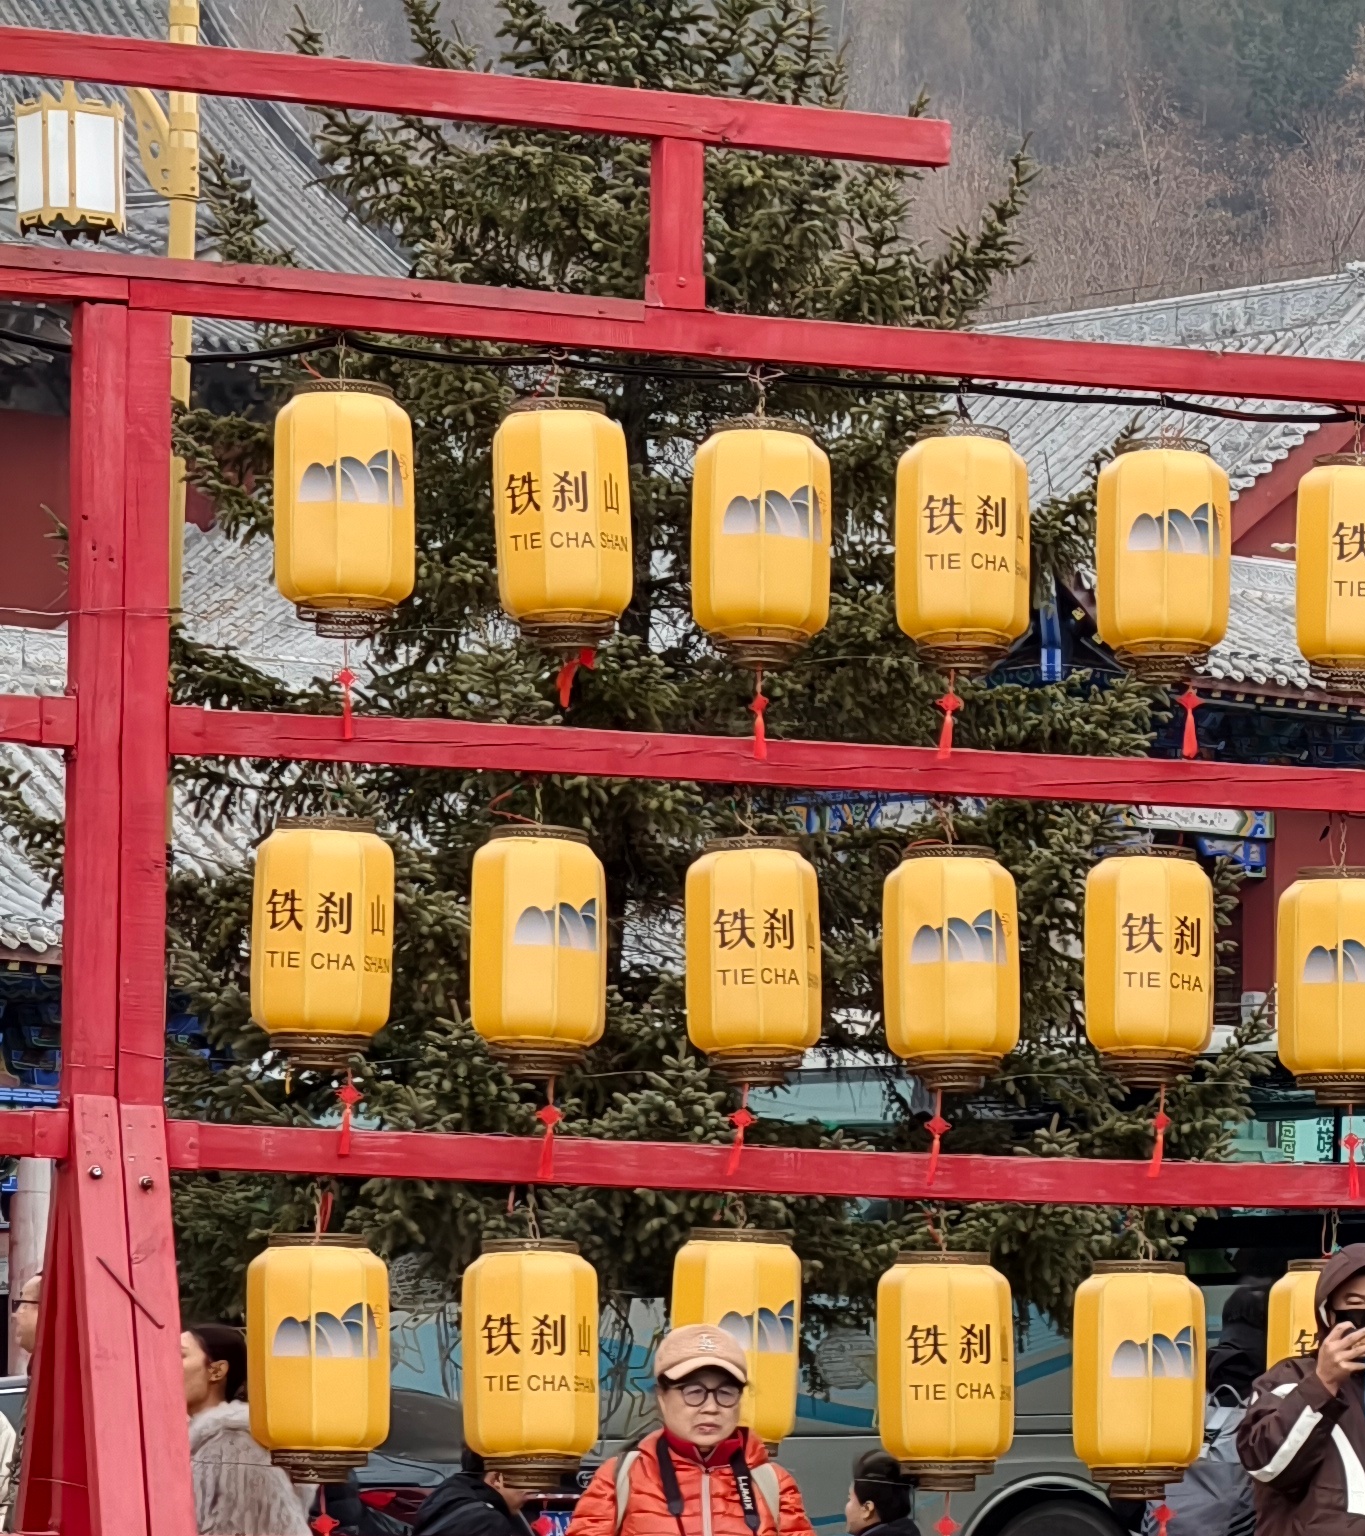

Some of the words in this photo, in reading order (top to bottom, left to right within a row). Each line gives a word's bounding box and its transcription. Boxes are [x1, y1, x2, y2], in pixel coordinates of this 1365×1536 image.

[504, 470, 620, 515] 铁刹山
[509, 531, 543, 551] TIE
[549, 531, 596, 549] CHA
[599, 531, 628, 552] SHAN
[924, 552, 962, 571] TIE
[970, 552, 1010, 573] CHA
[265, 888, 386, 936] 铁刹山
[1121, 912, 1201, 957] 铁刹
[265, 950, 301, 968] TIE
[310, 952, 356, 971] CHA
[716, 967, 756, 986] TIE
[760, 967, 800, 986] CHA
[1122, 971, 1161, 988] TIE
[1169, 972, 1203, 992] CHA
[480, 1313, 591, 1357] 铁刹山
[483, 1375, 522, 1392] TIE
[527, 1375, 571, 1392] CHA
[908, 1383, 948, 1400] TIE
[956, 1382, 995, 1400] CHA
[737, 1475, 754, 1510] LUMIX
